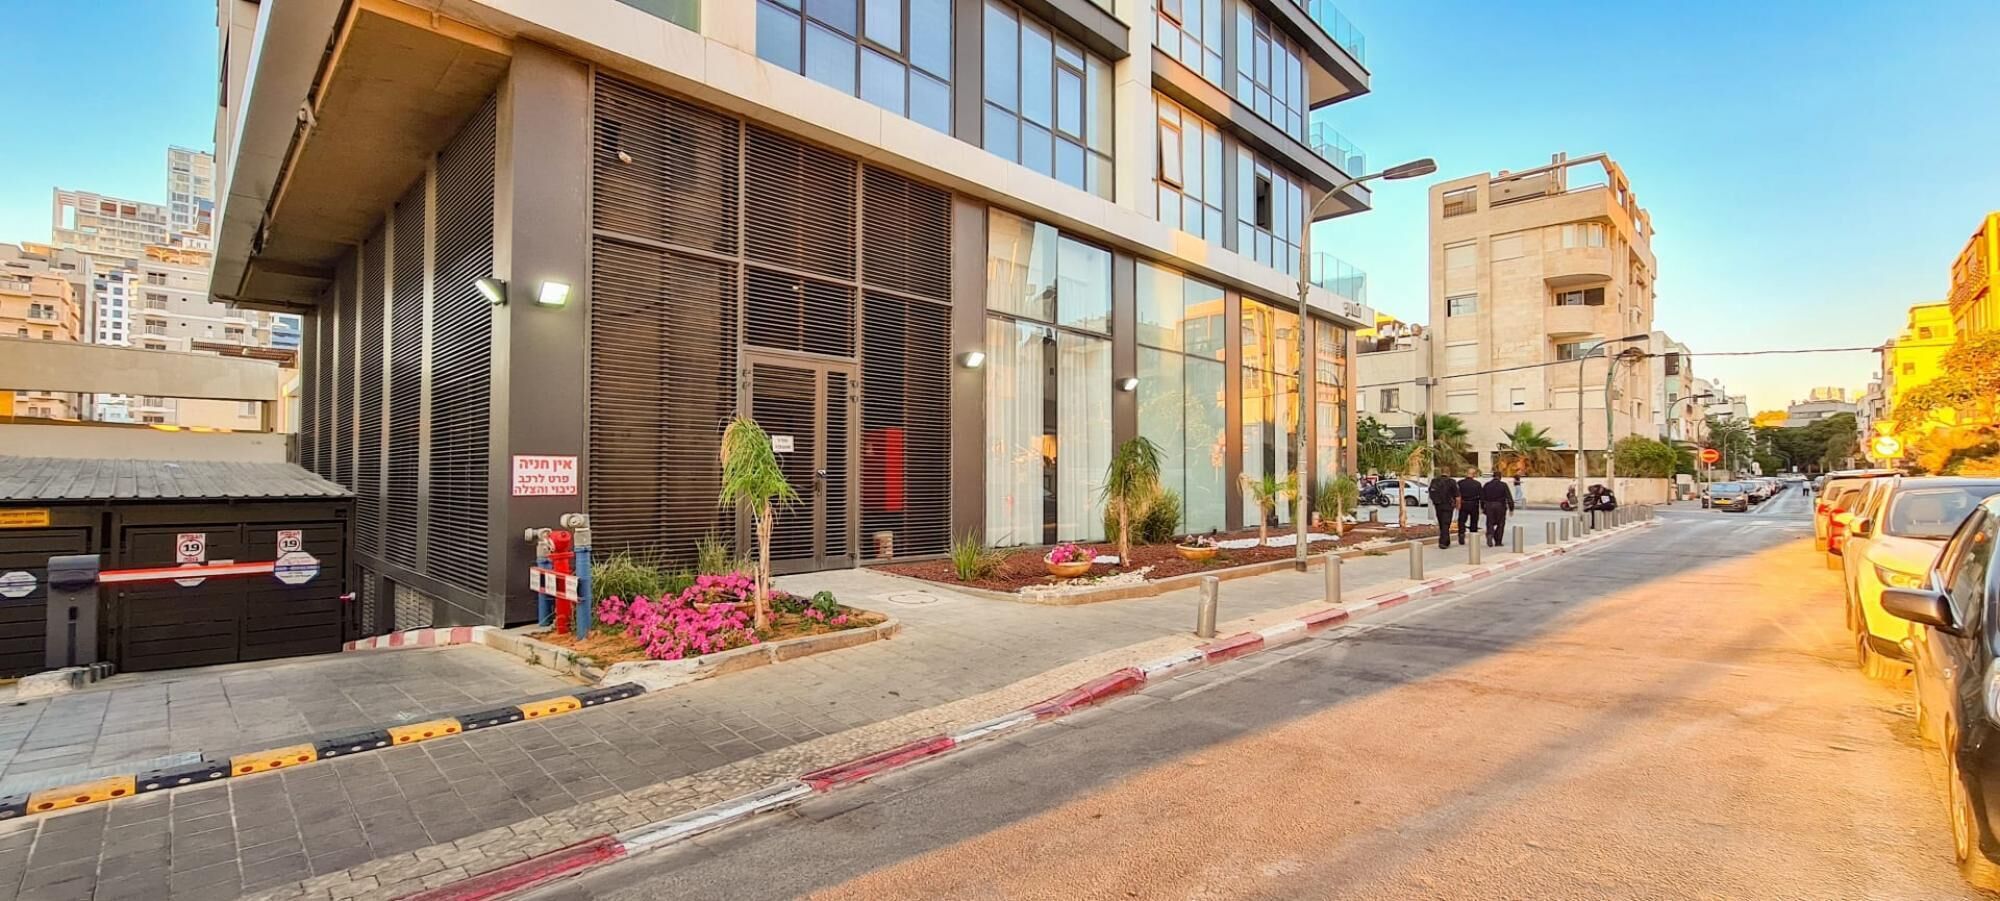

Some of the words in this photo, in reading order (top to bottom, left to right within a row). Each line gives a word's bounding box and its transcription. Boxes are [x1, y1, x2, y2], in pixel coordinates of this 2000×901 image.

[519, 459, 549, 469] חניה
[553, 459, 572, 472] אין
[518, 473, 545, 483] לרכב
[548, 475, 569, 483] פרט
[514, 484, 548, 494] והצלה
[551, 486, 576, 494] כיבוי
[182, 543, 200, 551] 19
[282, 540, 297, 548] 19
